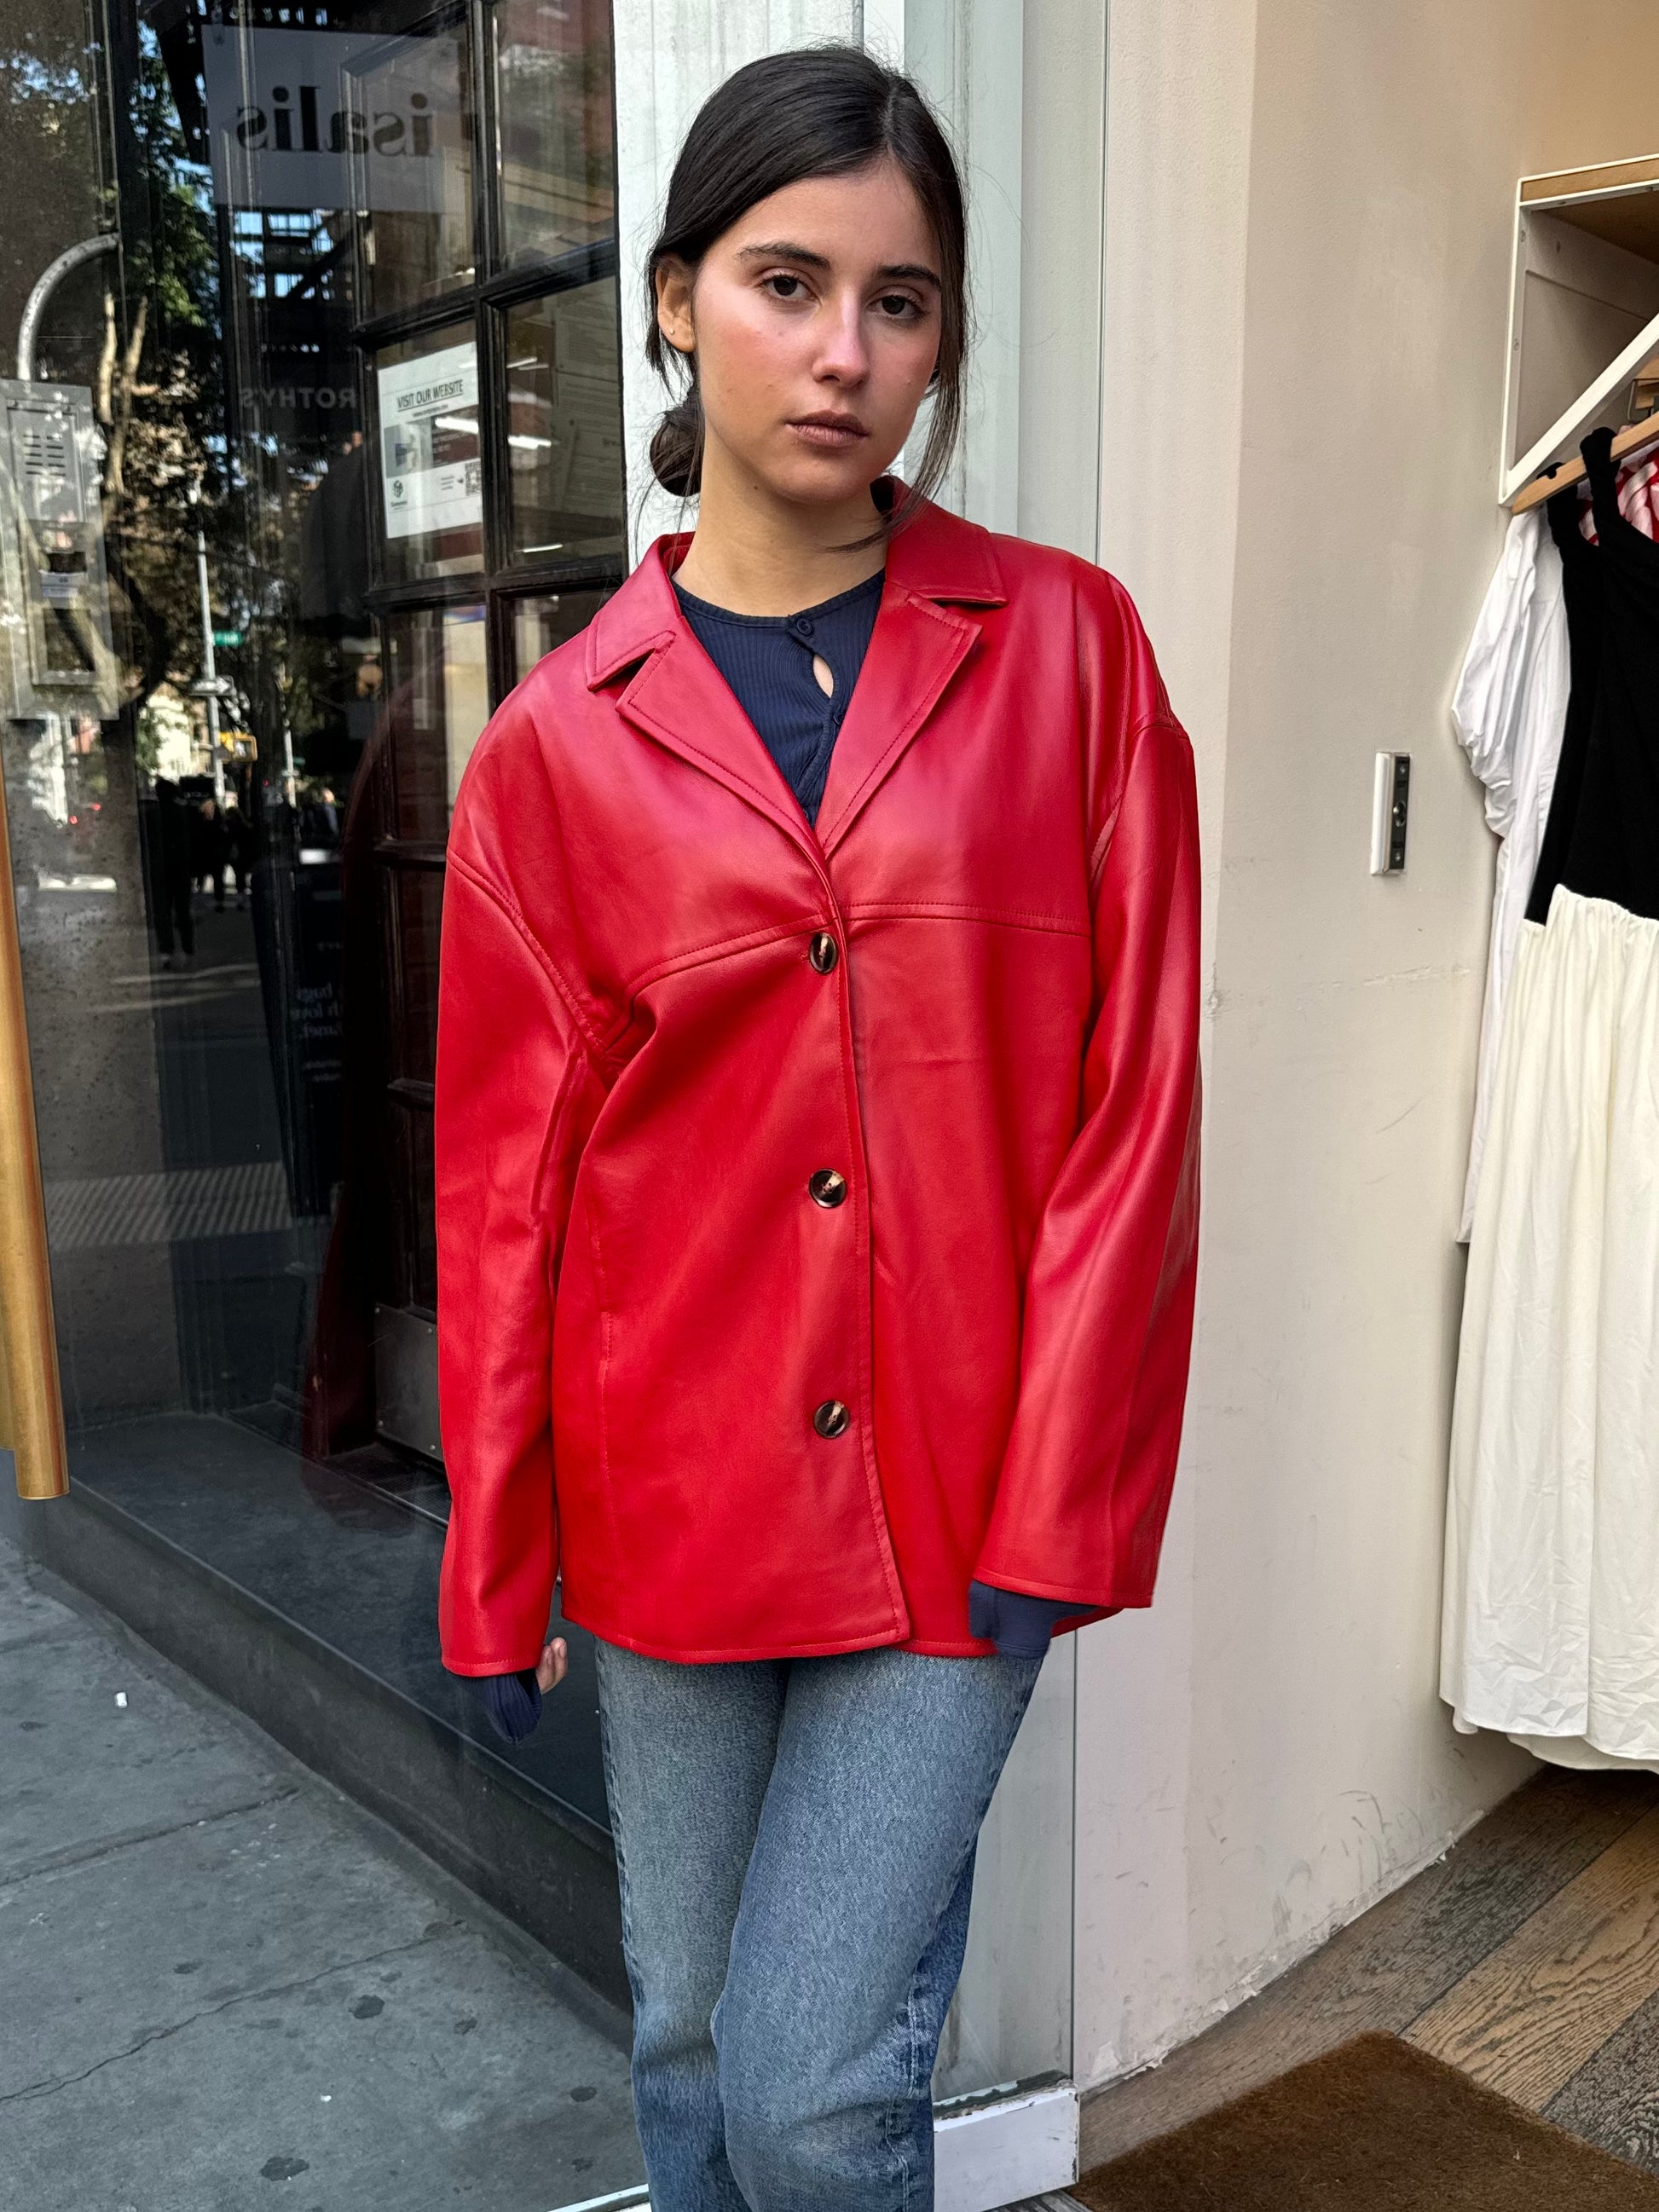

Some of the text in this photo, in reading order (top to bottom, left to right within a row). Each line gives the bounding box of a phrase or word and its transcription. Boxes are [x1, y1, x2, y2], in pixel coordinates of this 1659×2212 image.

[396, 378, 463, 408] VISIT OUR WEBSITE
